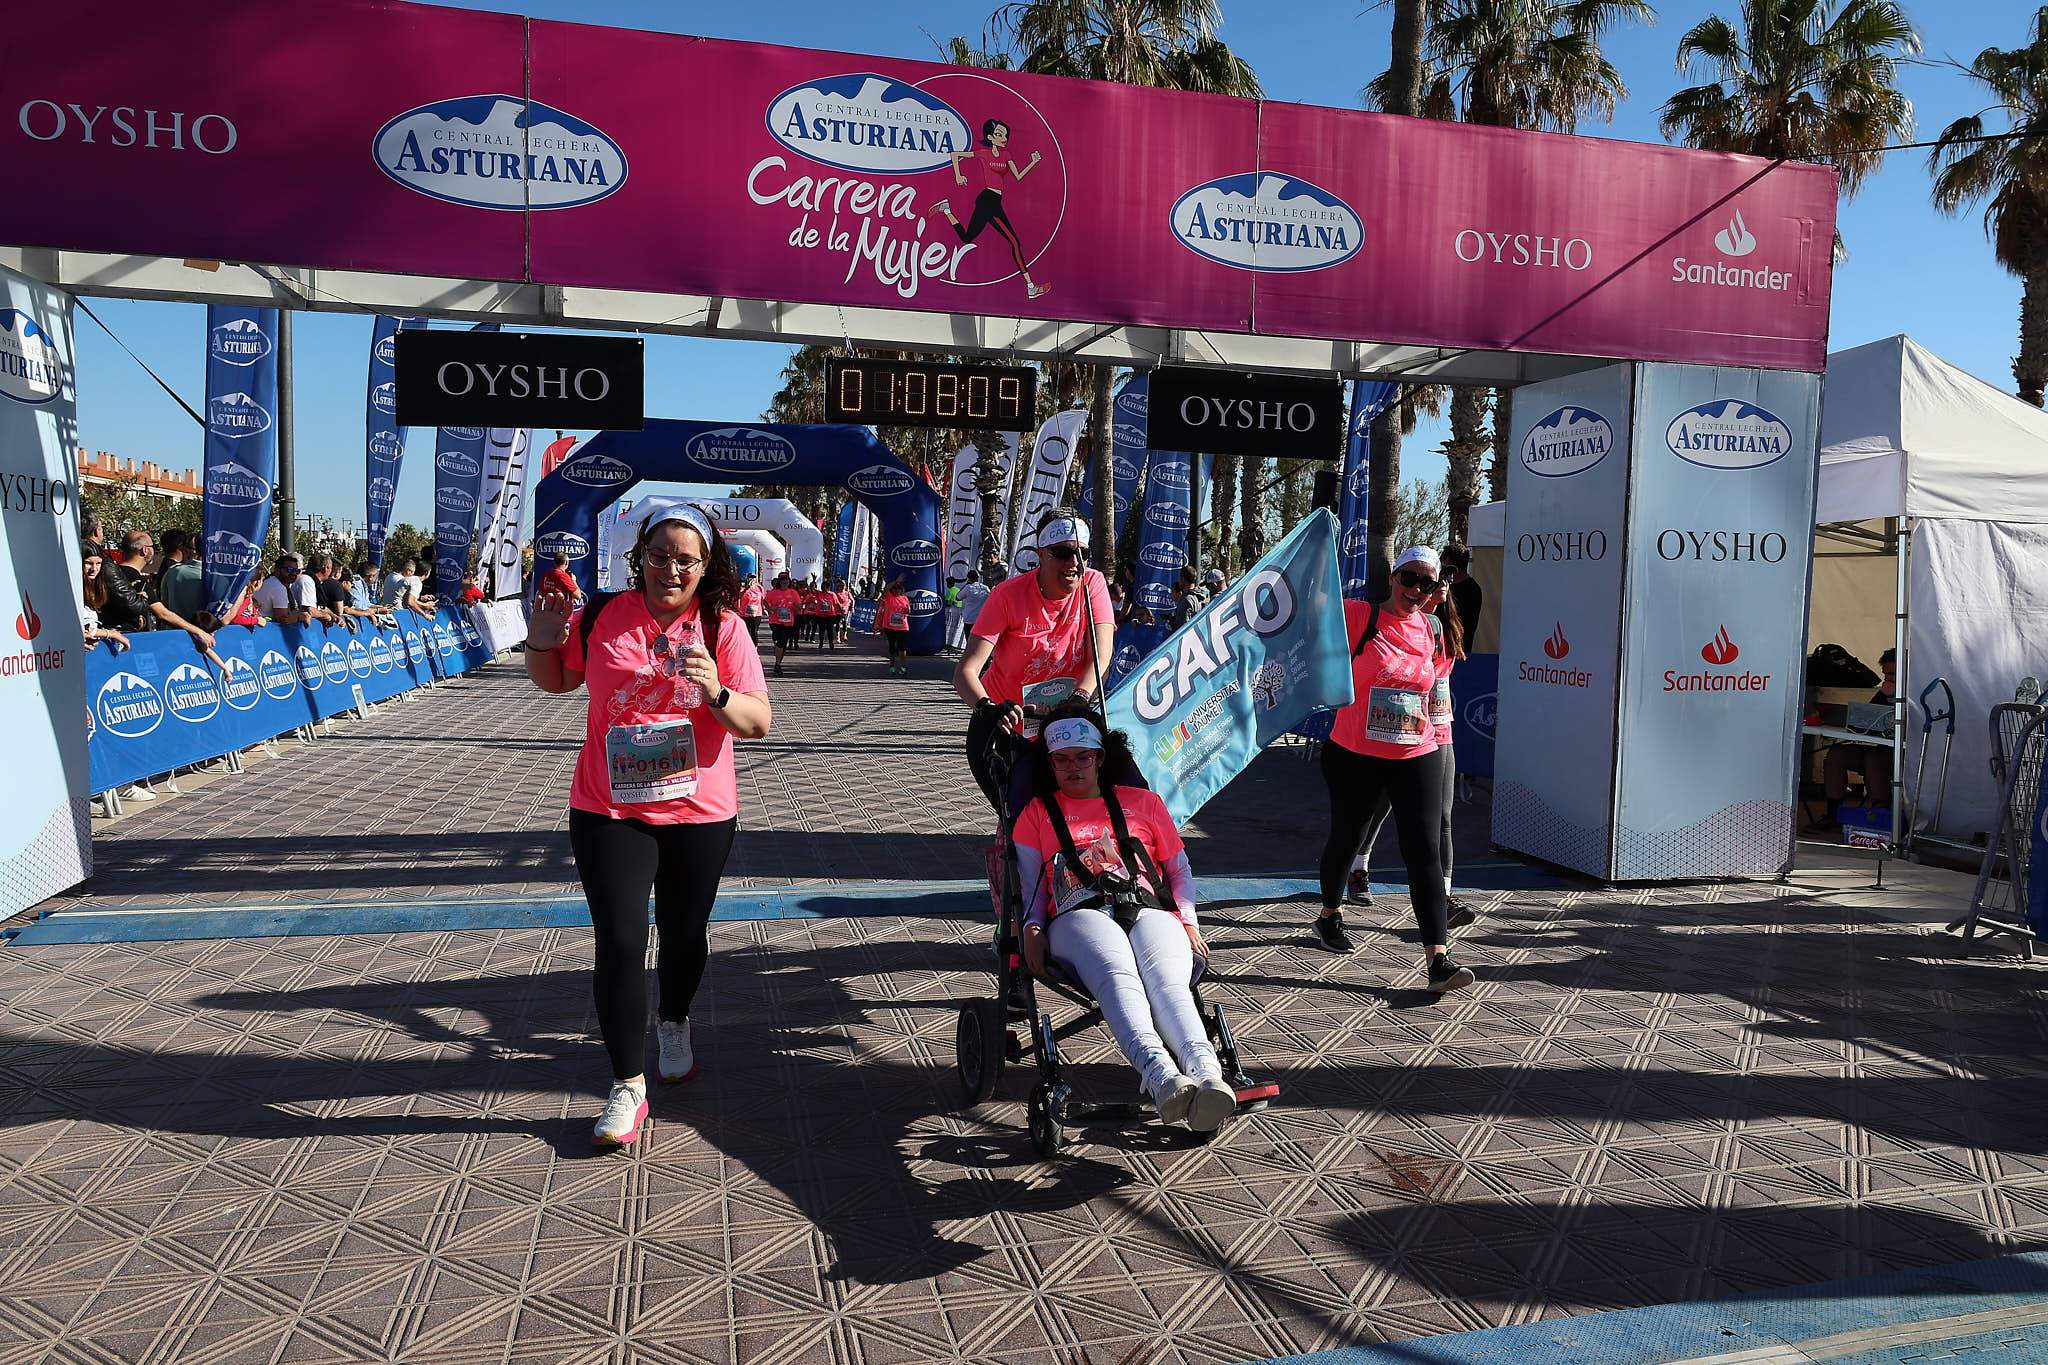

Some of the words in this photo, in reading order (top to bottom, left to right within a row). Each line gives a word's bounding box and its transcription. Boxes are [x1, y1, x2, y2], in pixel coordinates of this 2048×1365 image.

[18, 99, 238, 155] OYSHO
[782, 101, 955, 154] ASTURIANA
[815, 102, 880, 118] CENTRAL
[886, 110, 950, 125] LECHERA
[433, 129, 513, 146] CENTRAL
[522, 137, 601, 153] LECHERA
[394, 129, 609, 186] ASTURIANA
[747, 156, 917, 220] Carrera
[1185, 202, 1350, 251] ASTURIANA
[1216, 202, 1277, 216] CENTRAL
[1282, 207, 1345, 222] LECHERA
[789, 213, 820, 249] de
[828, 214, 850, 252] la
[844, 215, 977, 298] Mujer
[1454, 229, 1593, 271] OYSHO
[1671, 257, 1793, 291] Santander
[0, 350, 60, 388] TURIANA
[437, 361, 610, 401] OYSHO
[1180, 395, 1316, 433] OYSHO
[1694, 422, 1736, 431] CENTRAL
[1738, 424, 1780, 433] LECHERA
[1113, 431, 1146, 447] STURIANA
[1540, 431, 1569, 442] CENTRAL
[1571, 424, 1603, 437] LECHERA
[1674, 423, 1782, 454] ASTURIANA
[694, 439, 788, 463] ASTURIANA
[1526, 435, 1606, 464] ASTURIANA
[566, 465, 627, 480] ASTURIANA
[853, 477, 911, 489] ASTURIANA
[0, 472, 68, 516] YSHO
[1517, 529, 1608, 562] OYSHO
[1656, 529, 1788, 564] OYSHO
[1133, 567, 1296, 722] CAFO
[0, 647, 65, 678] antander
[1518, 660, 1593, 689] Santander
[224, 680, 260, 700] ASTURIANA
[1663, 670, 1771, 693] Santander
[103, 699, 161, 726] ASTURIANA
[170, 688, 218, 711] ASTURIANA
[1186, 680, 1242, 724] UNIVERSITAT
[1193, 705, 1219, 734] JAUME
